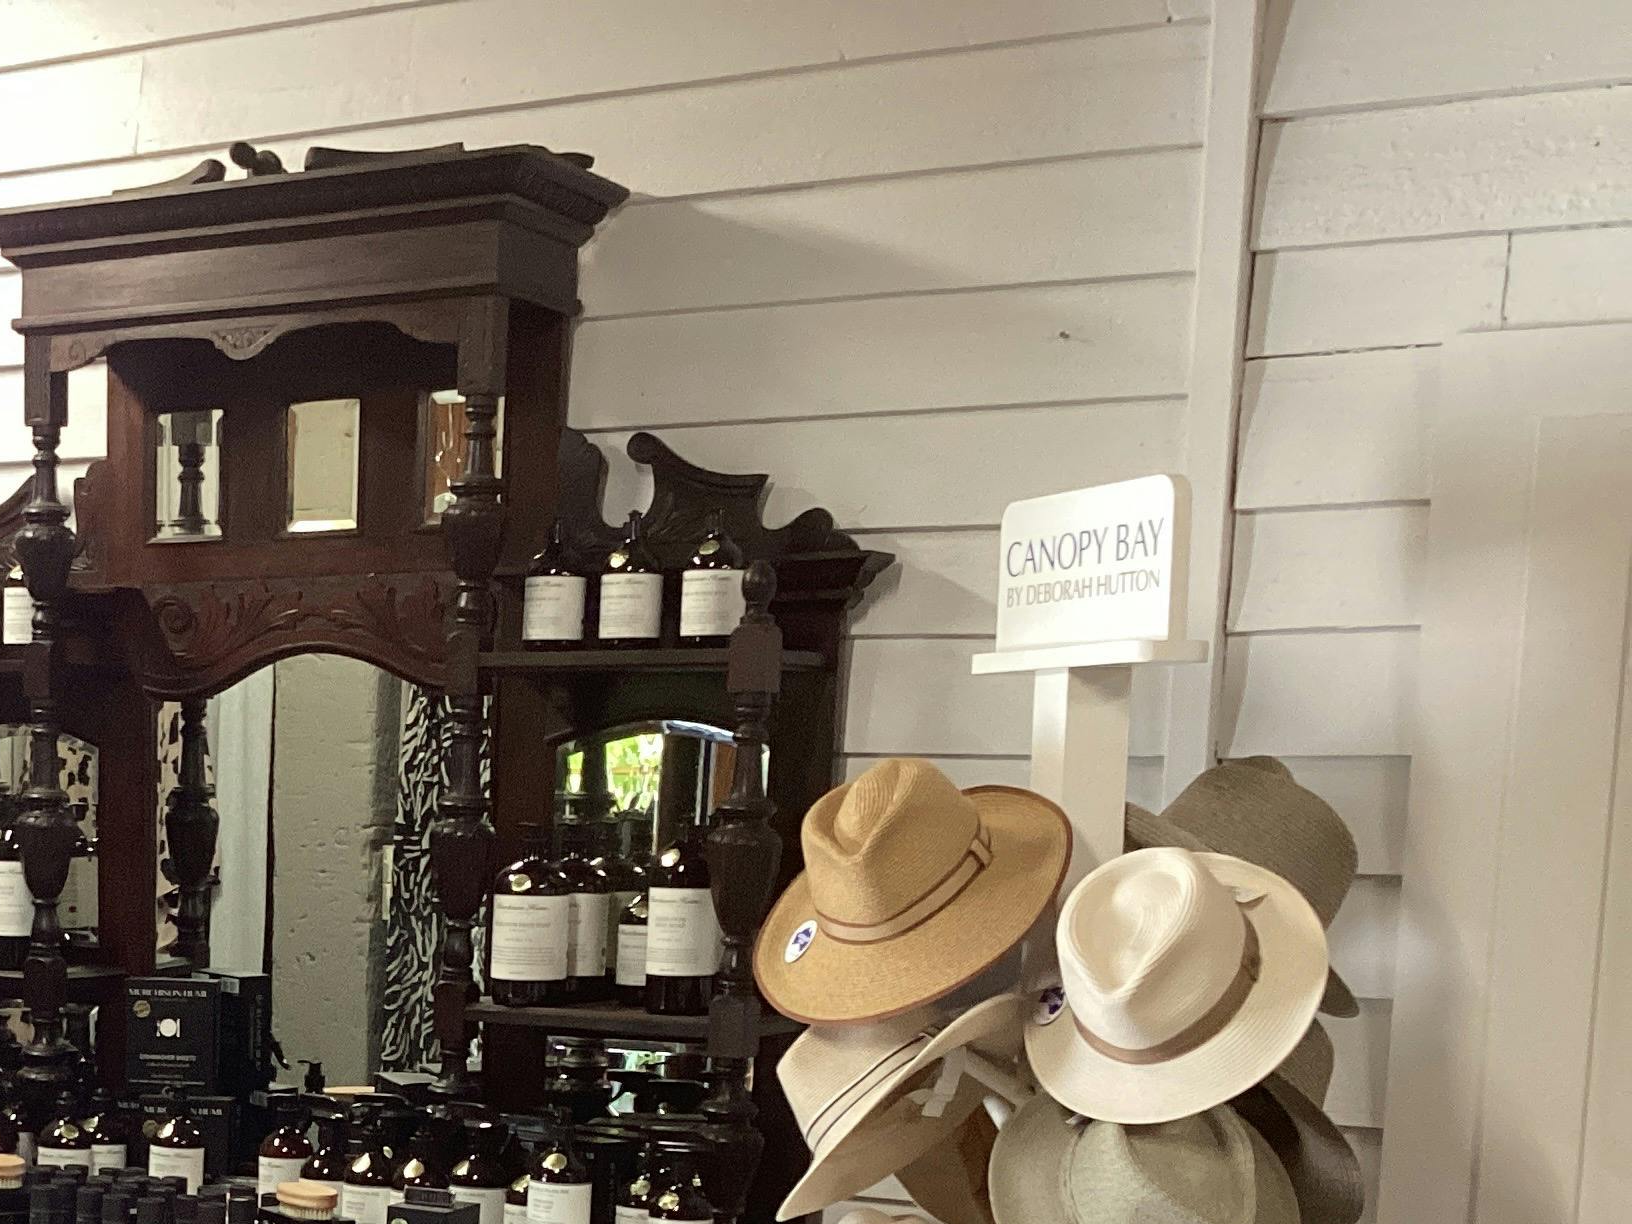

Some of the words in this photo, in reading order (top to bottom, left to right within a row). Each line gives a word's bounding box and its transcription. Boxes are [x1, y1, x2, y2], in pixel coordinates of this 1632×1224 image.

[1006, 526, 1109, 577] CANOPY
[1115, 517, 1165, 561] BAY
[1006, 585, 1025, 608] BY
[1026, 576, 1093, 606] DEBORAH
[1096, 569, 1161, 596] HUTTON
